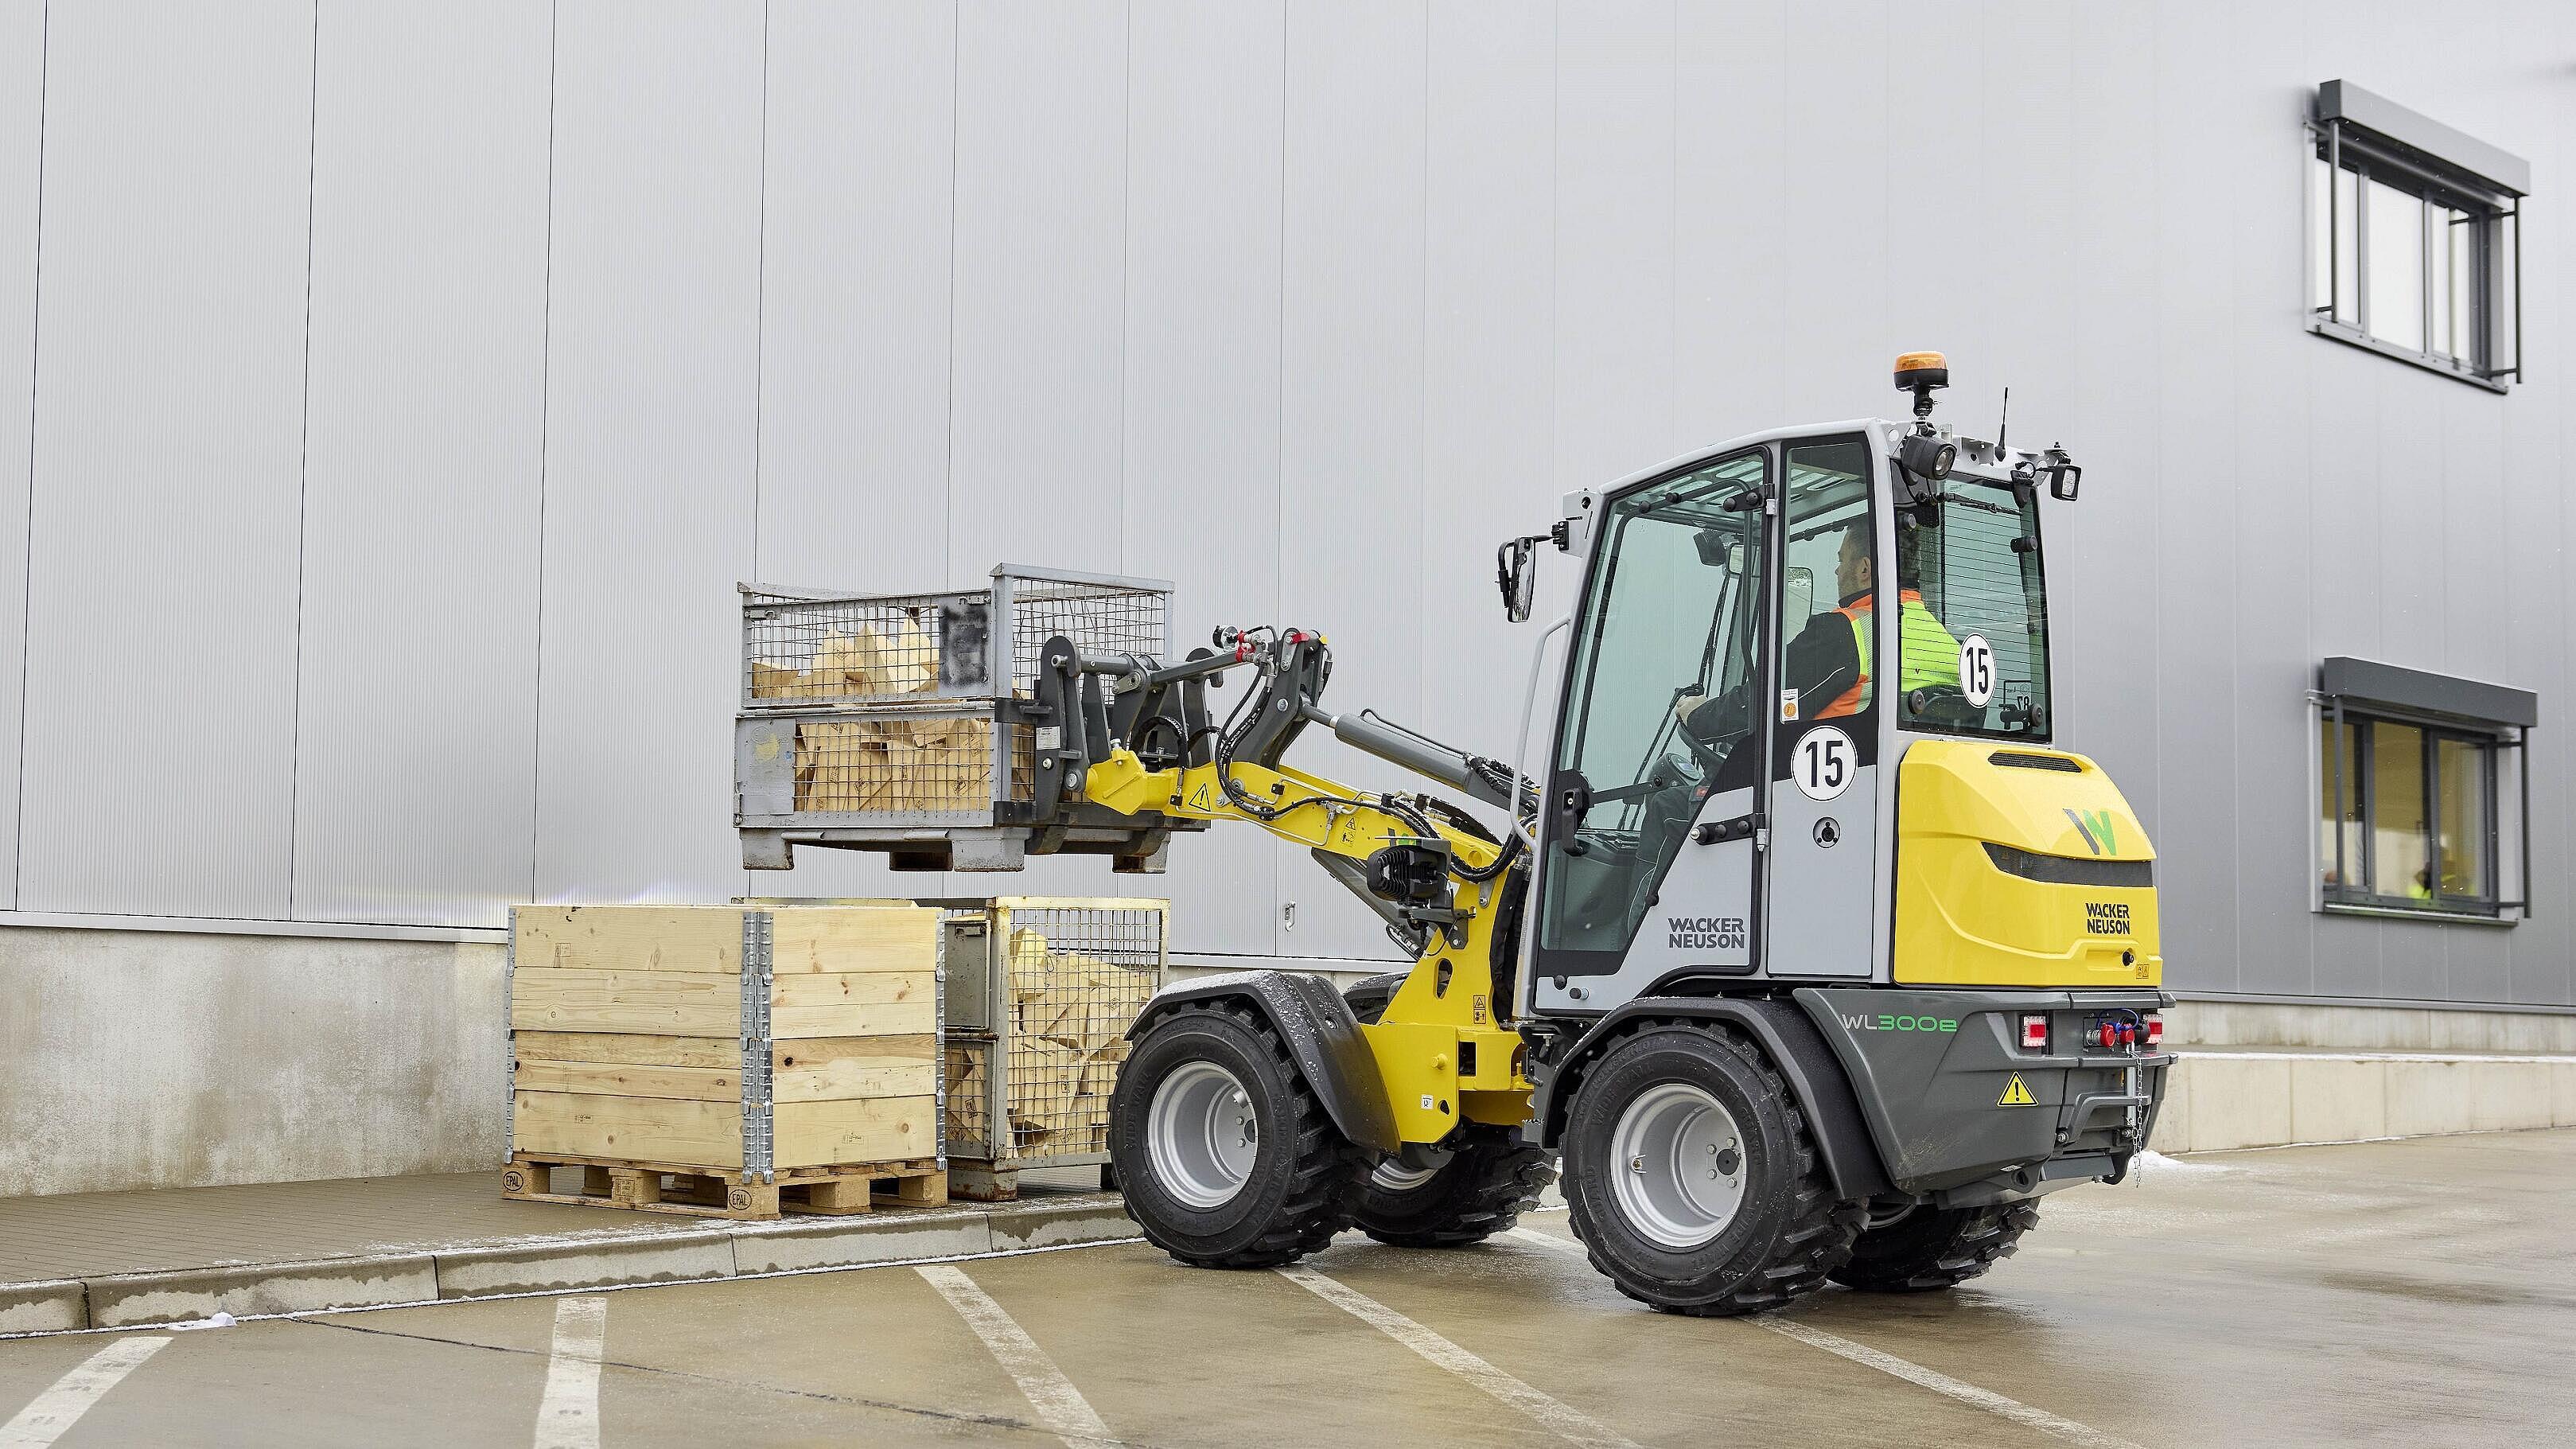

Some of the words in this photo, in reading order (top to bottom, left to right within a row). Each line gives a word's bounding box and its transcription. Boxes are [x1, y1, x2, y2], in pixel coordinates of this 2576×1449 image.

[1967, 646, 1989, 695] 15
[1805, 739, 1843, 788] 15
[2085, 902, 2130, 919] WACKER
[1667, 917, 1745, 933] WACKER
[2087, 919, 2130, 935] NEUSON
[1668, 934, 1745, 948] NEUSON
[1842, 1014, 1958, 1032] WL300e
[505, 1175, 519, 1187] EPAL
[732, 1194, 748, 1206] EPAL
